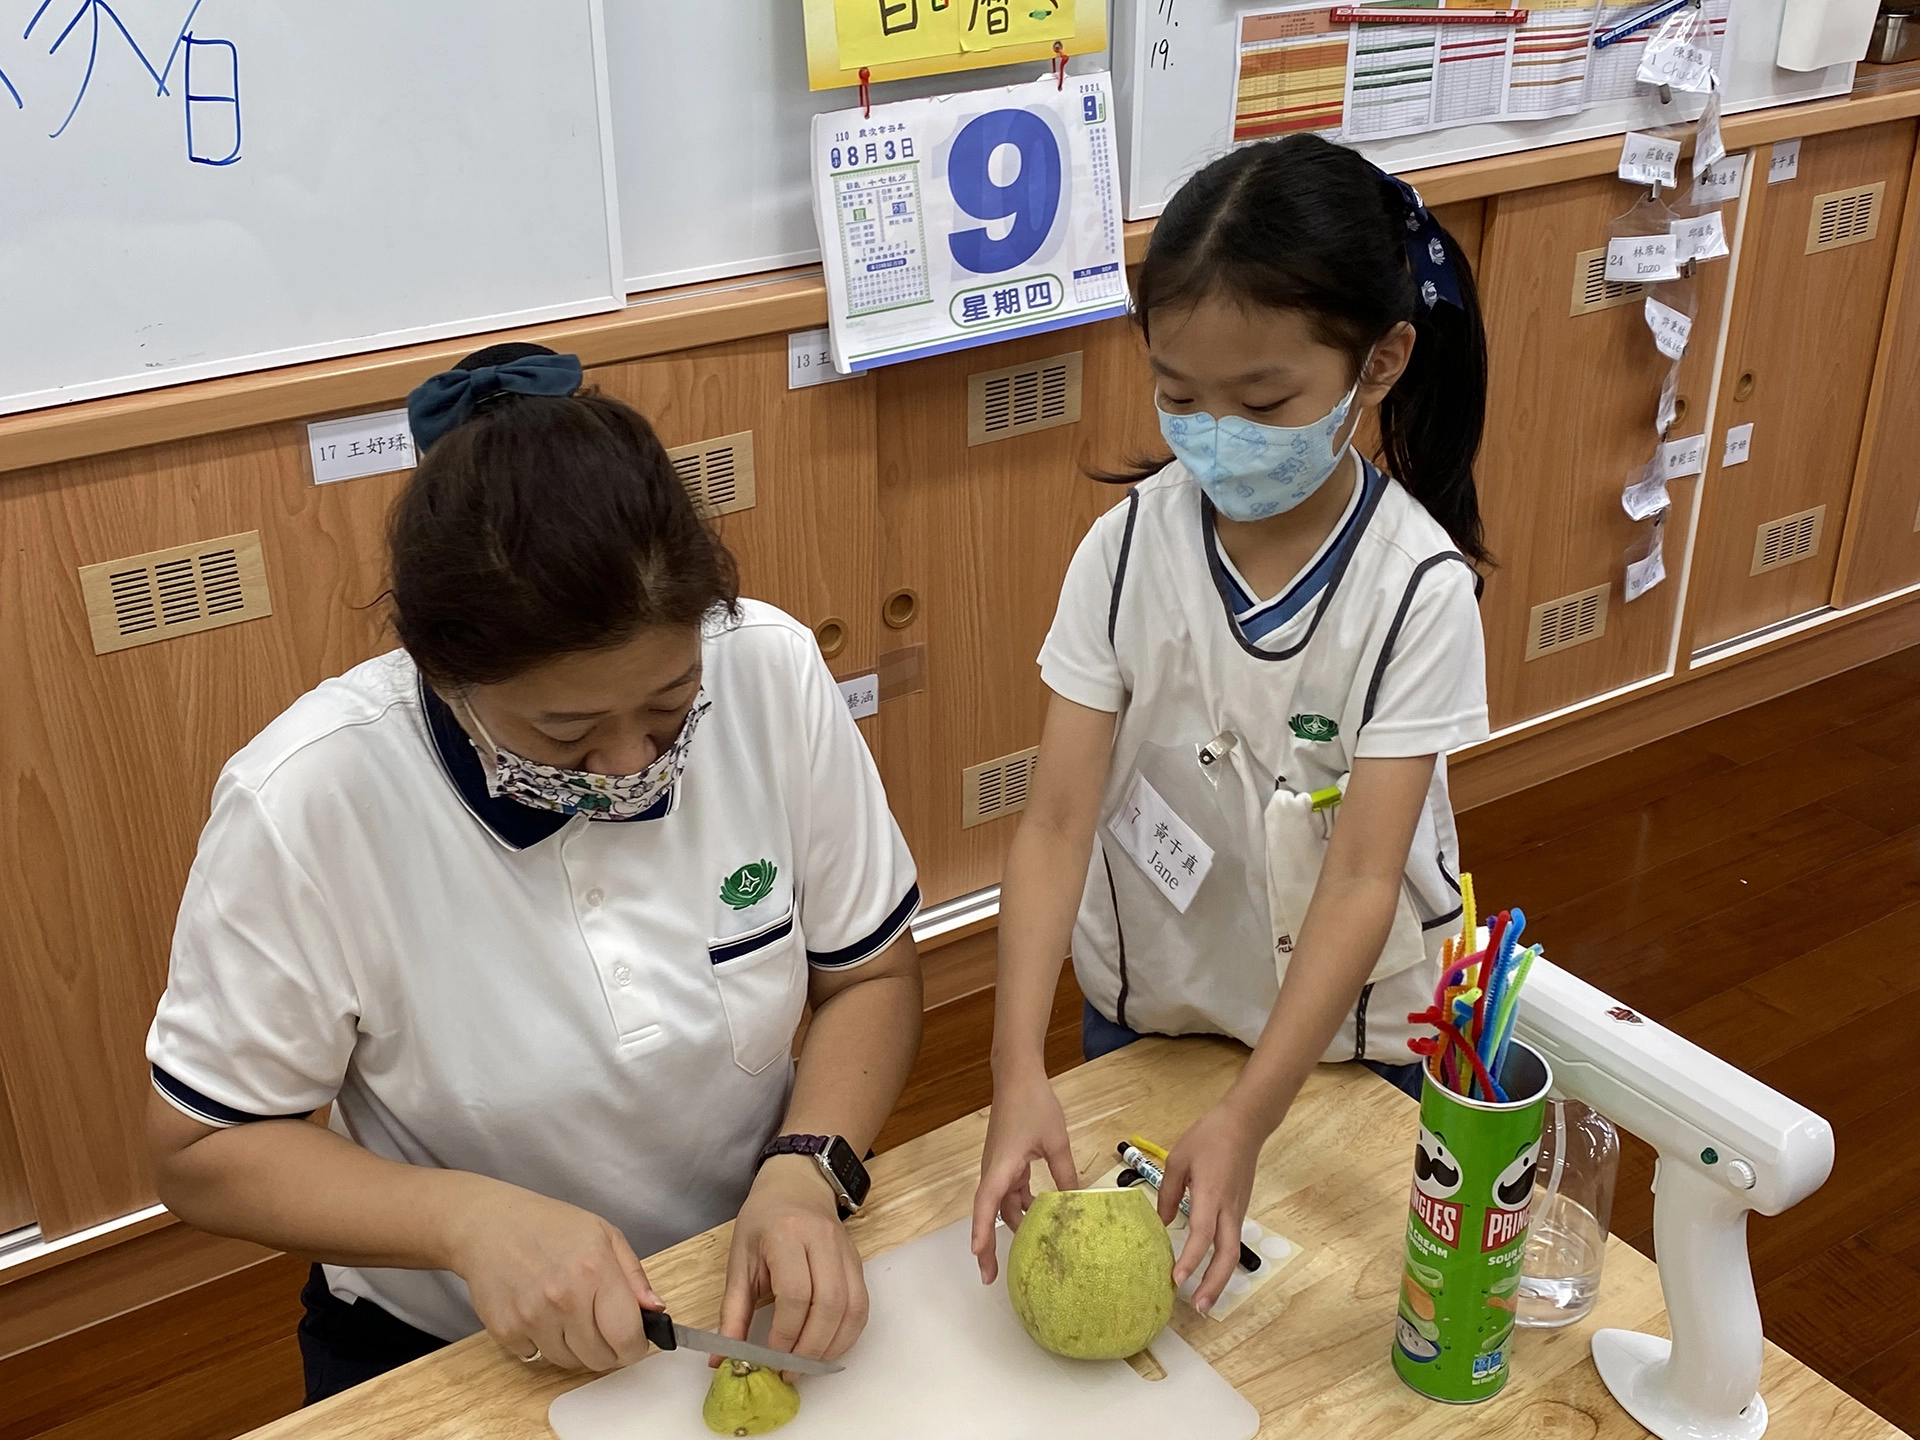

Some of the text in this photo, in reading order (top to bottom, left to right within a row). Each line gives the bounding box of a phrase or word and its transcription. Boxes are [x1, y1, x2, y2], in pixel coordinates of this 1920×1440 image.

[1150, 38, 1174, 70] 19.
[1080, 82, 1100, 93] 2021
[835, 131, 850, 142] 110
[1629, 152, 1637, 165] 2
[947, 108, 1061, 274] 9
[1610, 255, 1624, 266] 24
[1637, 262, 1661, 274] Enzo
[962, 282, 1053, 323] 星期四
[797, 351, 831, 368] 13 王
[320, 444, 336, 461] 17
[1147, 850, 1179, 890] Jane
[1413, 1229, 1448, 1259] CREAM
[1487, 1248, 1518, 1266] SOUR
